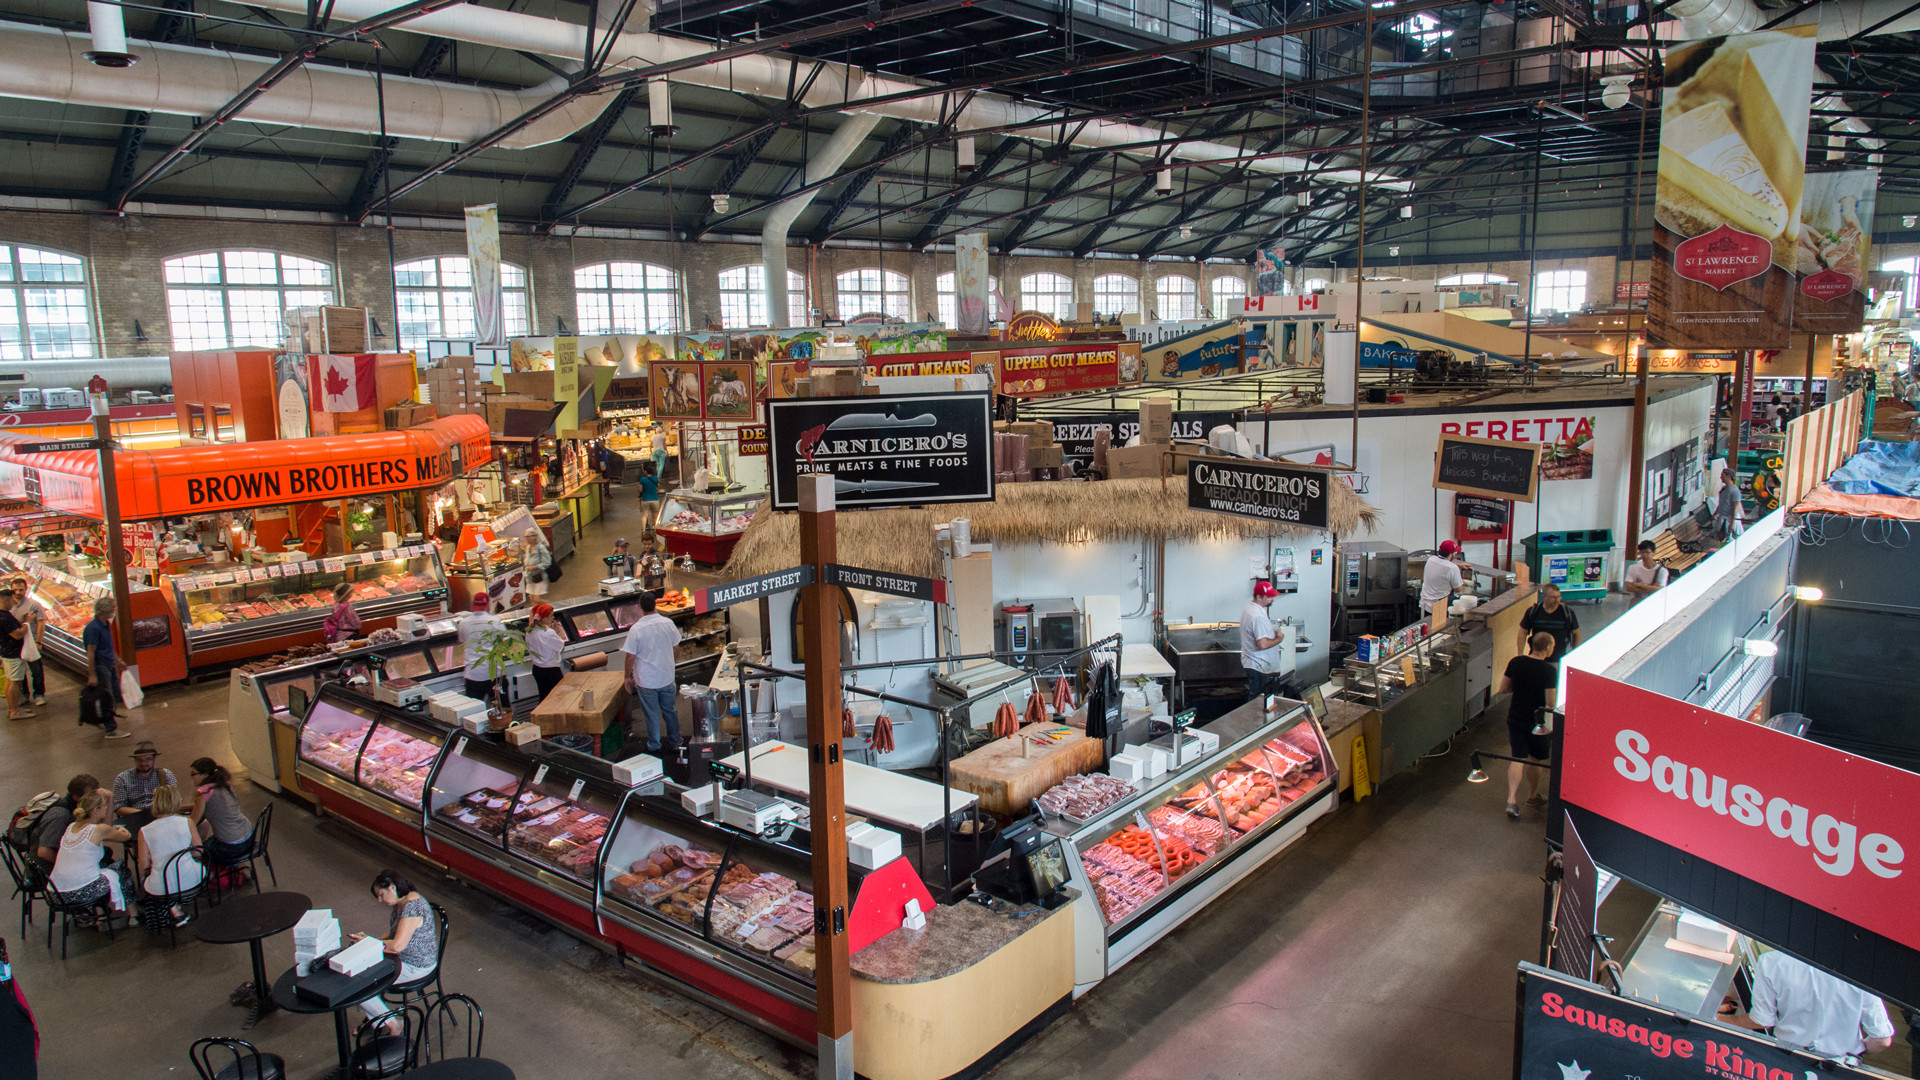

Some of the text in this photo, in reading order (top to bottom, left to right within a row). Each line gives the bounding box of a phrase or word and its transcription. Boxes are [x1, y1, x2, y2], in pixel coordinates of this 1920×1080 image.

[1698, 255, 1759, 266] LAWRENCE
[1676, 315, 1759, 324] stlawrencemarket.com
[1129, 327, 1152, 344] Wine
[1003, 350, 1116, 371] UPPER CUT MEATS
[1364, 347, 1416, 363] BAKERY
[1626, 356, 1720, 369] PLCEWARES
[882, 363, 915, 377] CUT
[917, 359, 971, 376] MEATS
[611, 381, 644, 398] Olympic
[1048, 379, 1067, 387] RETAIL
[61, 442, 91, 450] STREET
[1075, 445, 1095, 453] Pleas
[1446, 446, 1468, 462] This
[796, 457, 968, 473] PRIME MEATS & FINE FOODS
[1442, 465, 1476, 477] delicious
[187, 471, 281, 505] BROWN
[289, 459, 408, 495] BROTHERS
[415, 451, 451, 481] MEATS
[1195, 464, 1320, 498] CARNICERO'S
[1204, 486, 1308, 511] MERCADO LUNCH
[1210, 498, 1300, 521] www.carnicero's.ca
[134, 535, 155, 547] Bacon
[713, 572, 801, 603] MARKET STREET
[838, 570, 918, 593] FRONT STREET
[1613, 729, 1905, 879] Sausage
[1541, 992, 1694, 1058] Sausage
[1705, 1066, 1718, 1075] BY
